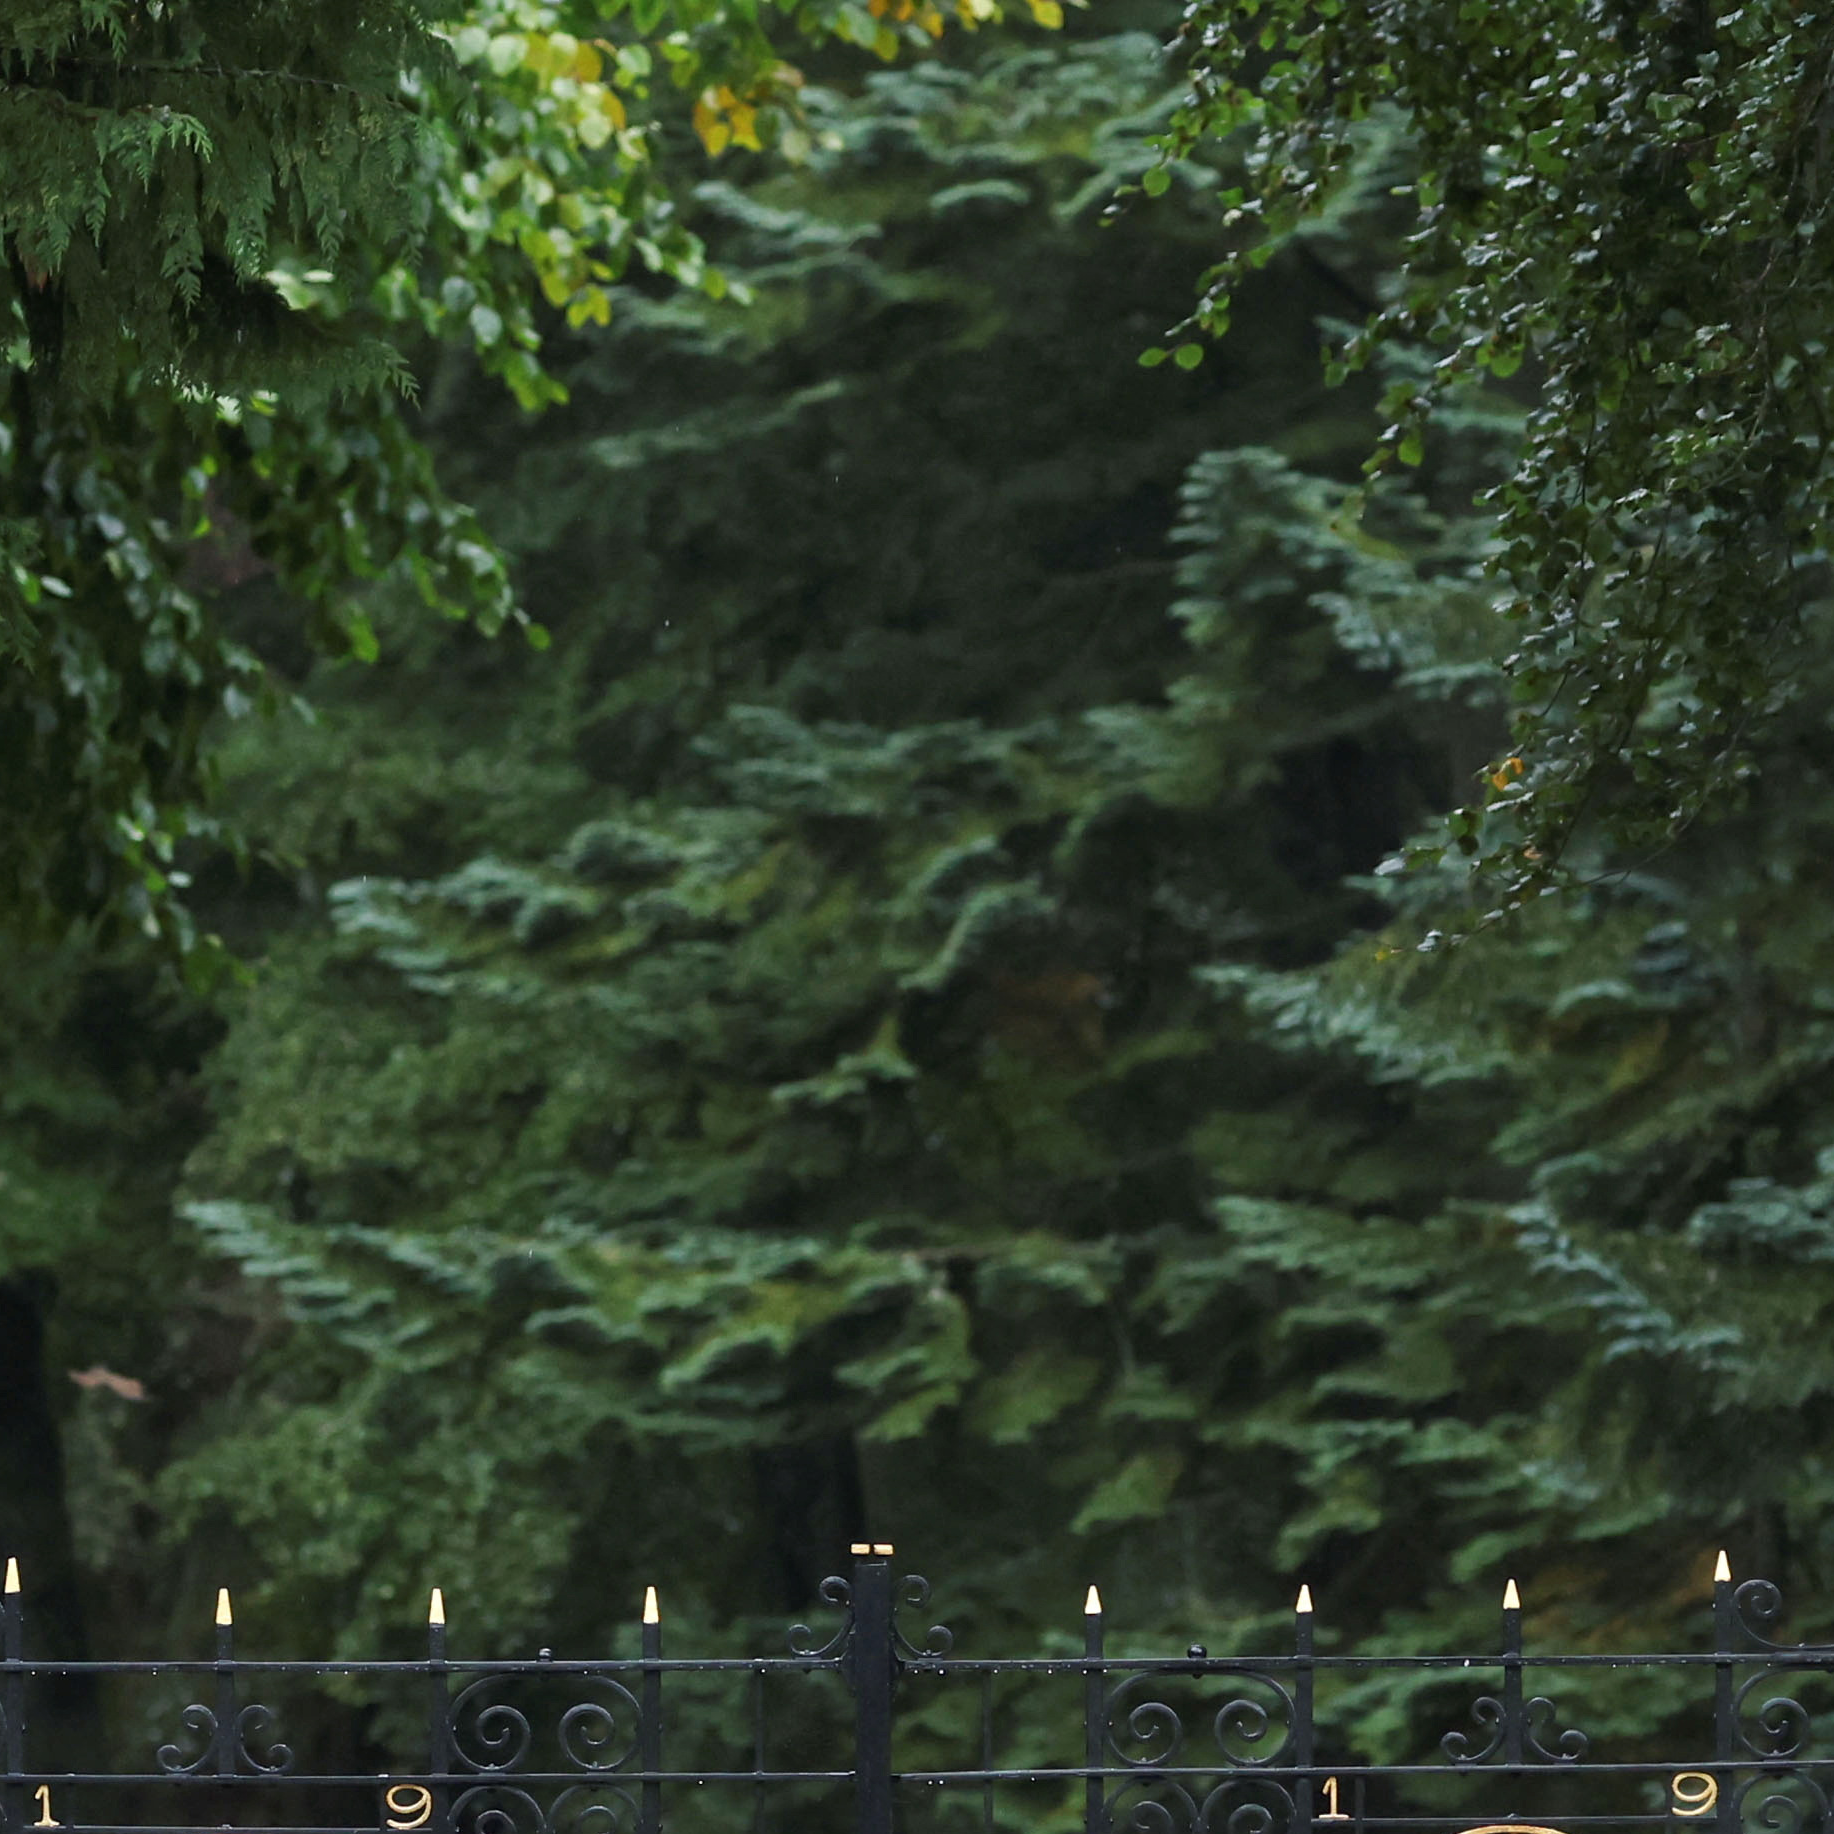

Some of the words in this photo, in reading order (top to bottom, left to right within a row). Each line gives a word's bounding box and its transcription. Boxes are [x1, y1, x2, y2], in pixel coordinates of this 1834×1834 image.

[34, 1784, 60, 1827] 1
[385, 1783, 432, 1830] 9
[1319, 1776, 1350, 1820] 1
[1672, 1771, 1718, 1816] 9
